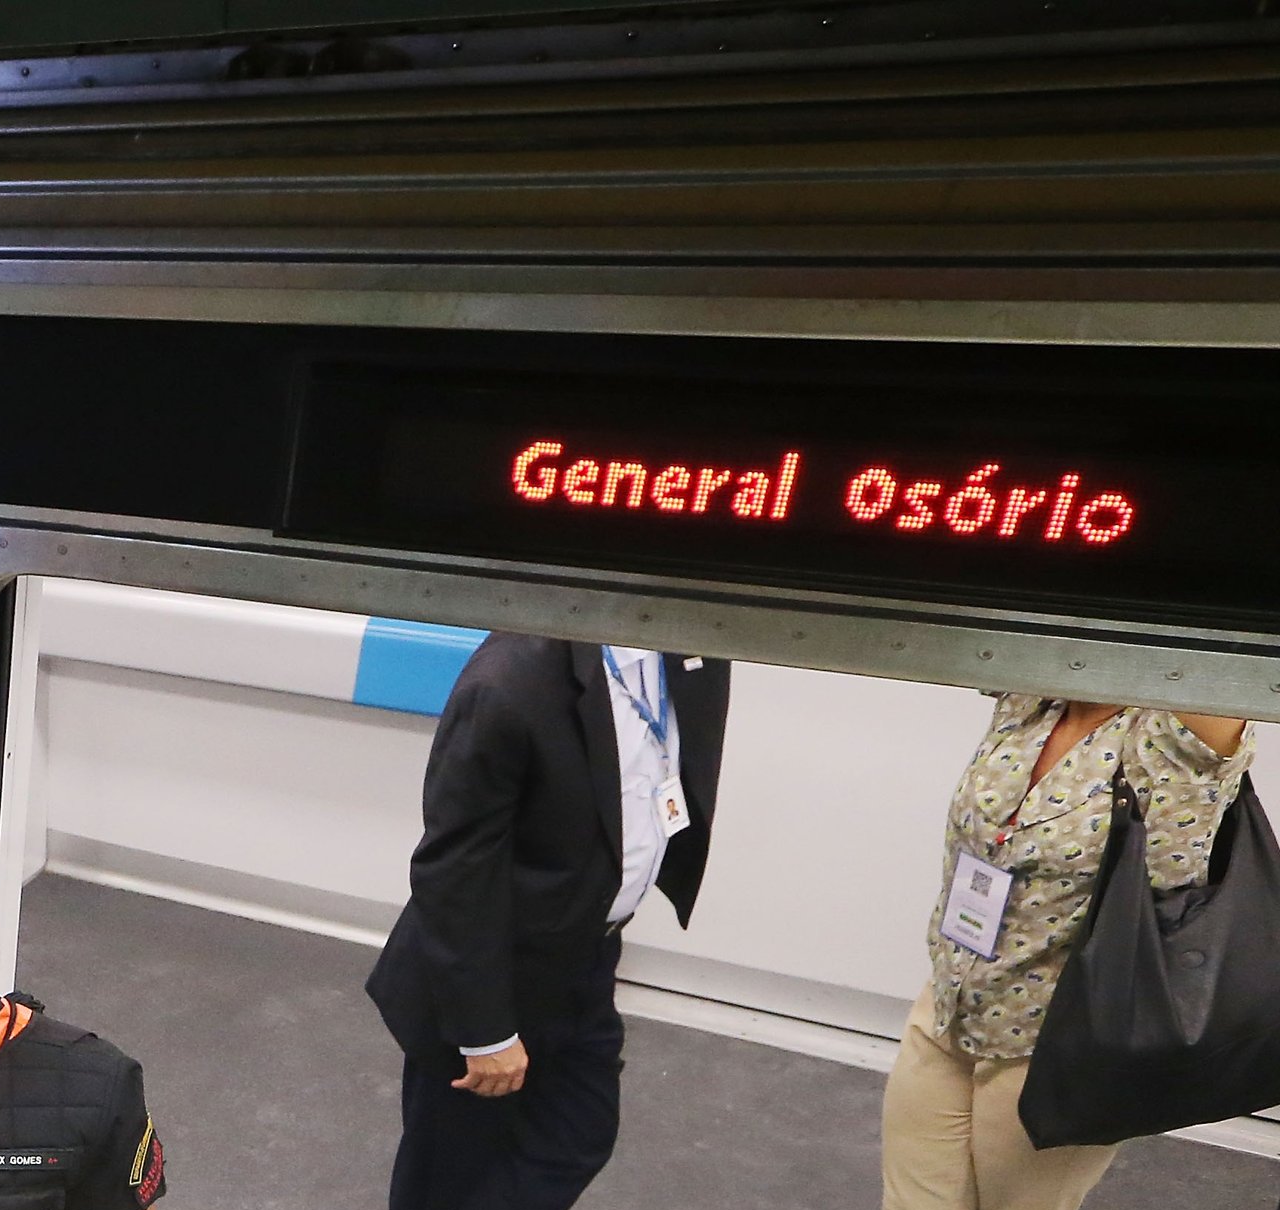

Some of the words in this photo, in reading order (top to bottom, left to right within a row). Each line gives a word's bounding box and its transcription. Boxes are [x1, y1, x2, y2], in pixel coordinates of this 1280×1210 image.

[512, 440, 802, 520] General
[845, 462, 1135, 544] Osório
[9, 1155, 43, 1165] GOMES
